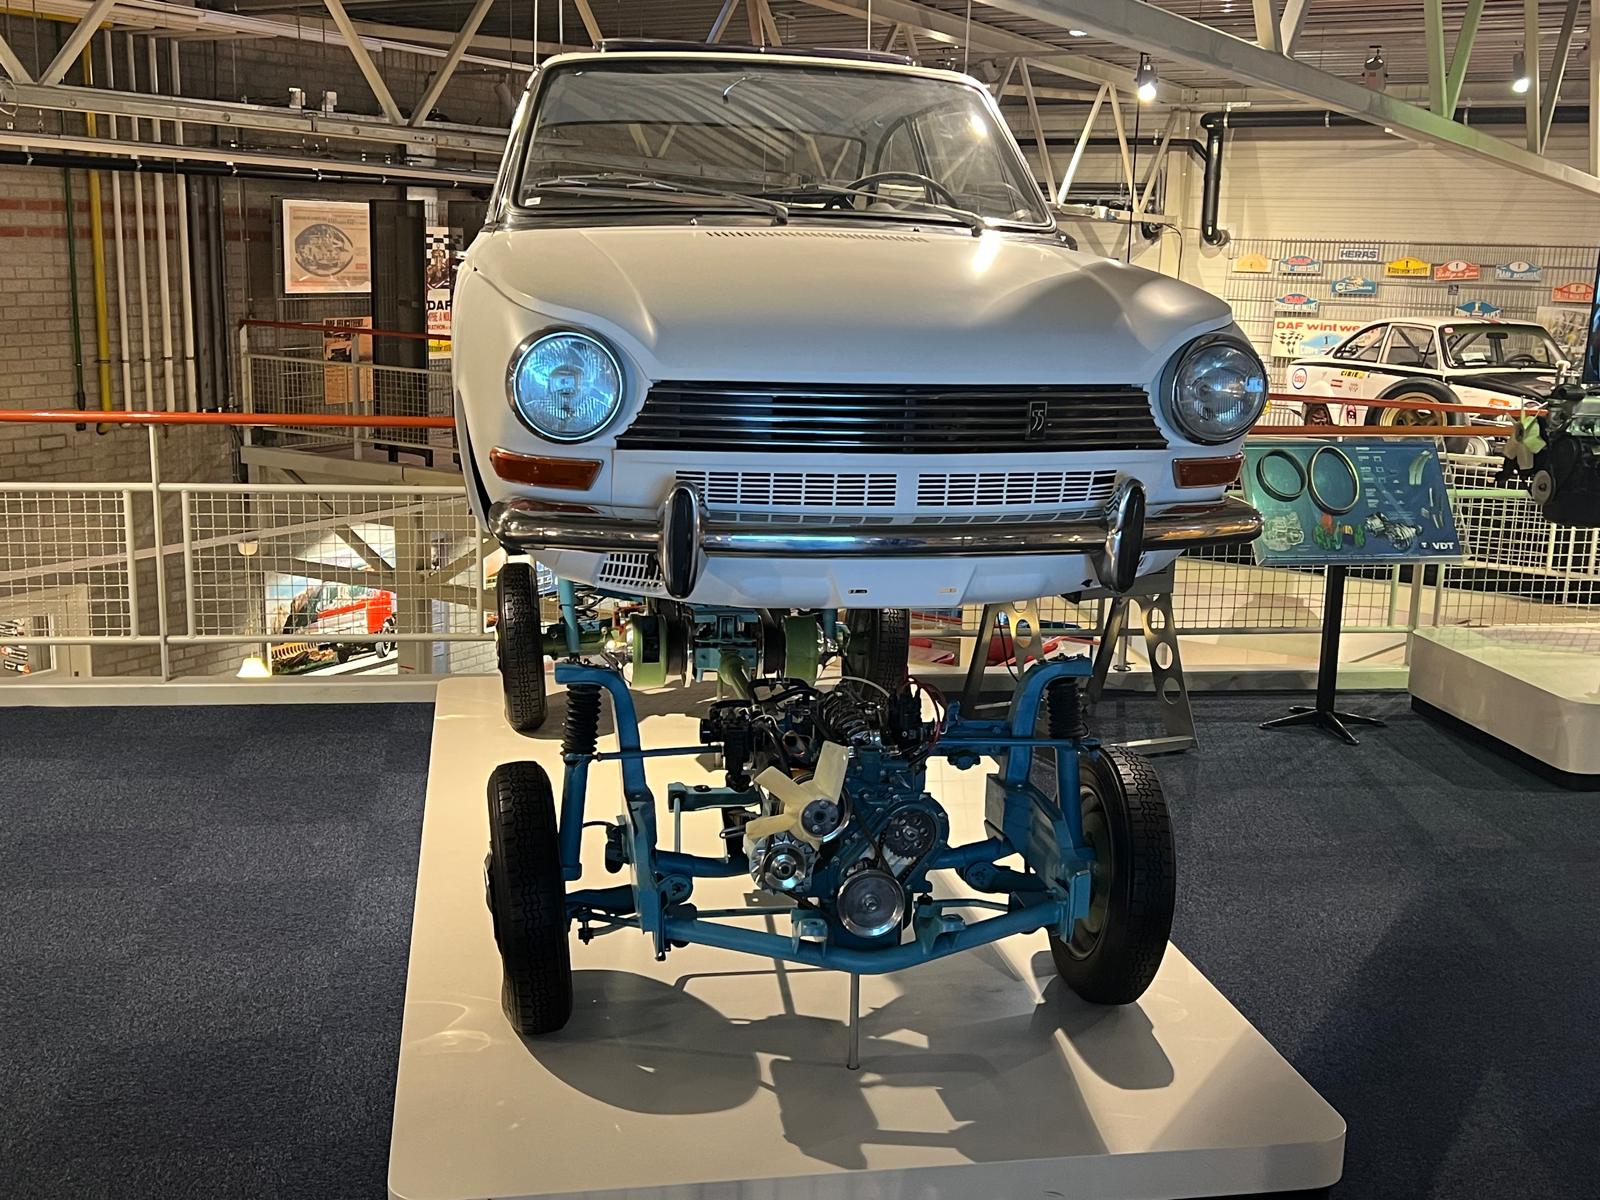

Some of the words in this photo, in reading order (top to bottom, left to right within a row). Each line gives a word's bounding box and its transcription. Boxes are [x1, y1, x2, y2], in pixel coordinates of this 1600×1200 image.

[1340, 250, 1377, 259] HERAS
[427, 300, 452, 310] DAF
[1276, 321, 1304, 330] DAF
[1307, 323, 1338, 332] wint
[1432, 542, 1454, 550] VDT
